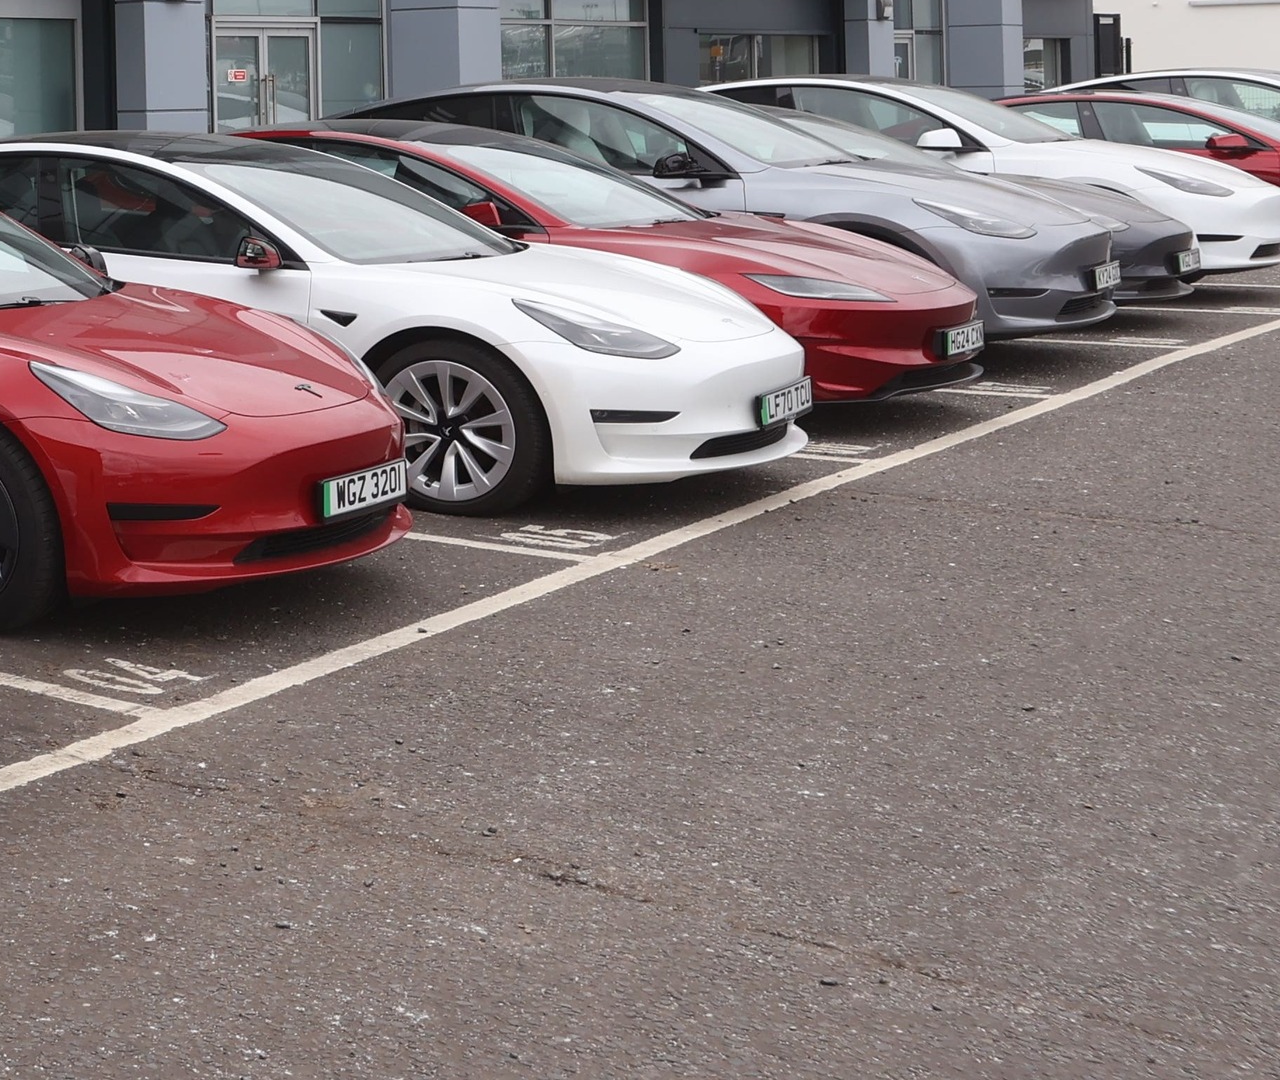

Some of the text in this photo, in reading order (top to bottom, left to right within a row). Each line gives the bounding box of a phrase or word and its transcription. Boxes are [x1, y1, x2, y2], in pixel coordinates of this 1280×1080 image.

[950, 330, 969, 352] HG24
[768, 381, 811, 419] LF70 TCU
[336, 465, 401, 509] WGZ 3201
[62, 657, 205, 695] 04
